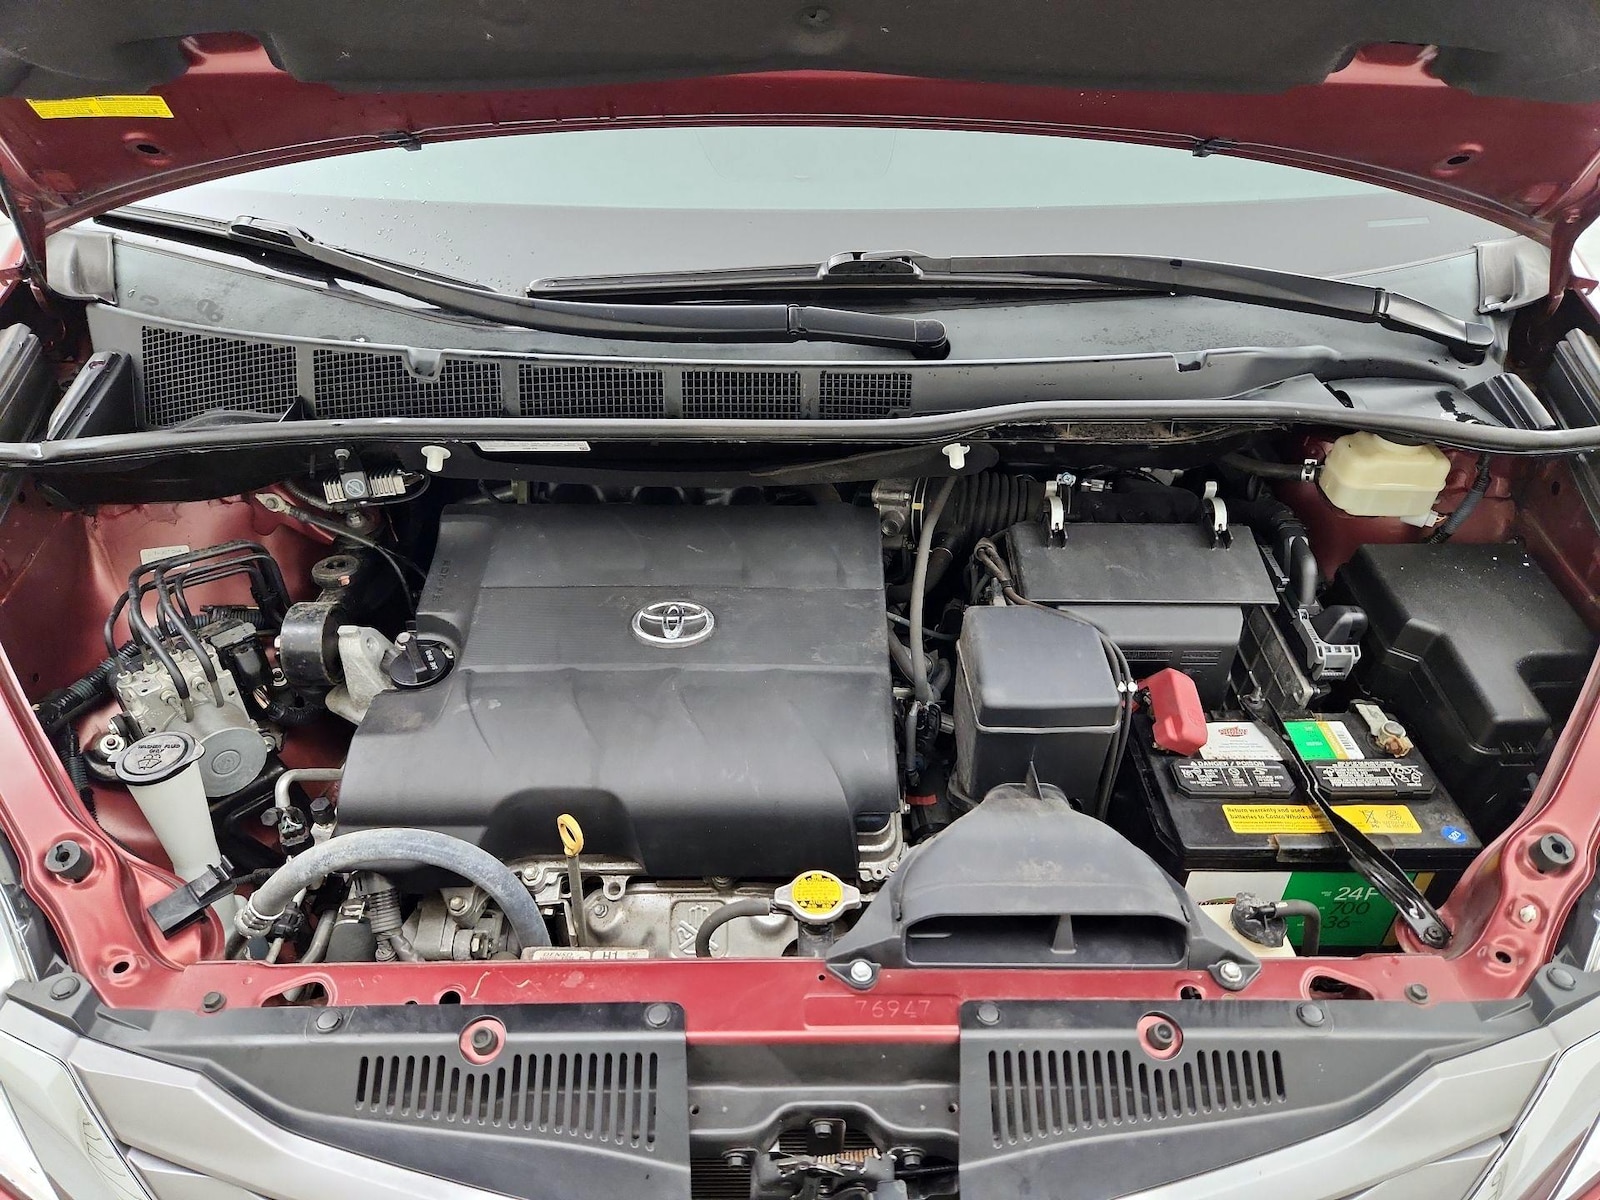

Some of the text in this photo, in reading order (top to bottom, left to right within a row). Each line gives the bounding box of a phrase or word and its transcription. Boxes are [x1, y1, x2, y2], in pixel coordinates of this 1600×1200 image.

[1333, 886, 1379, 901] 24F
[1328, 901, 1371, 916] 700
[1322, 915, 1352, 929] 36
[855, 1000, 931, 1018] 76947
